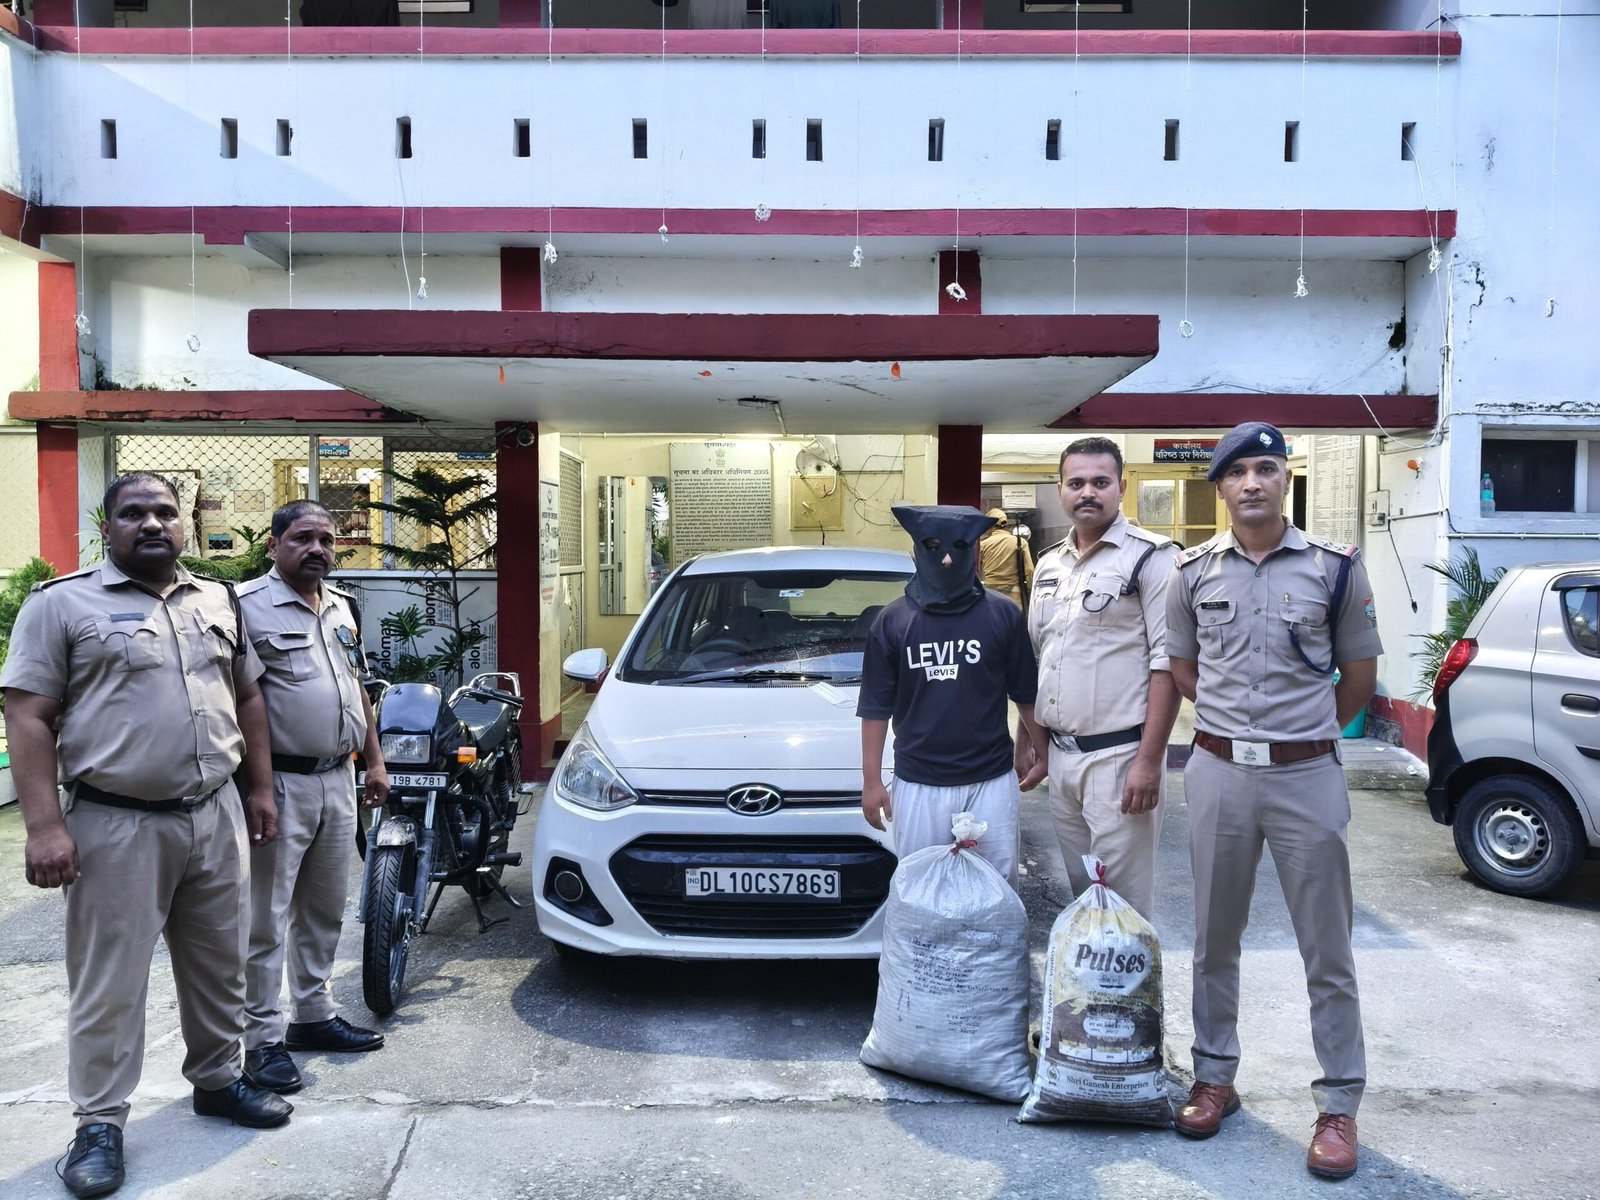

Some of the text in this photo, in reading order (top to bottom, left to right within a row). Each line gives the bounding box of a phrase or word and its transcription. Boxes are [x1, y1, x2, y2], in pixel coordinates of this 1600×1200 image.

[1172, 441, 1201, 449] कार्यालय
[906, 639, 981, 669] LEVI'S
[415, 776, 441, 786] 4781
[687, 877, 700, 885] IND
[700, 870, 836, 895] DL10CS7869
[1074, 943, 1146, 974] Pulses
[1066, 1075, 1082, 1085] Shri
[1083, 1079, 1110, 1089] Ganesh
[1111, 1081, 1149, 1091] Enterprises
